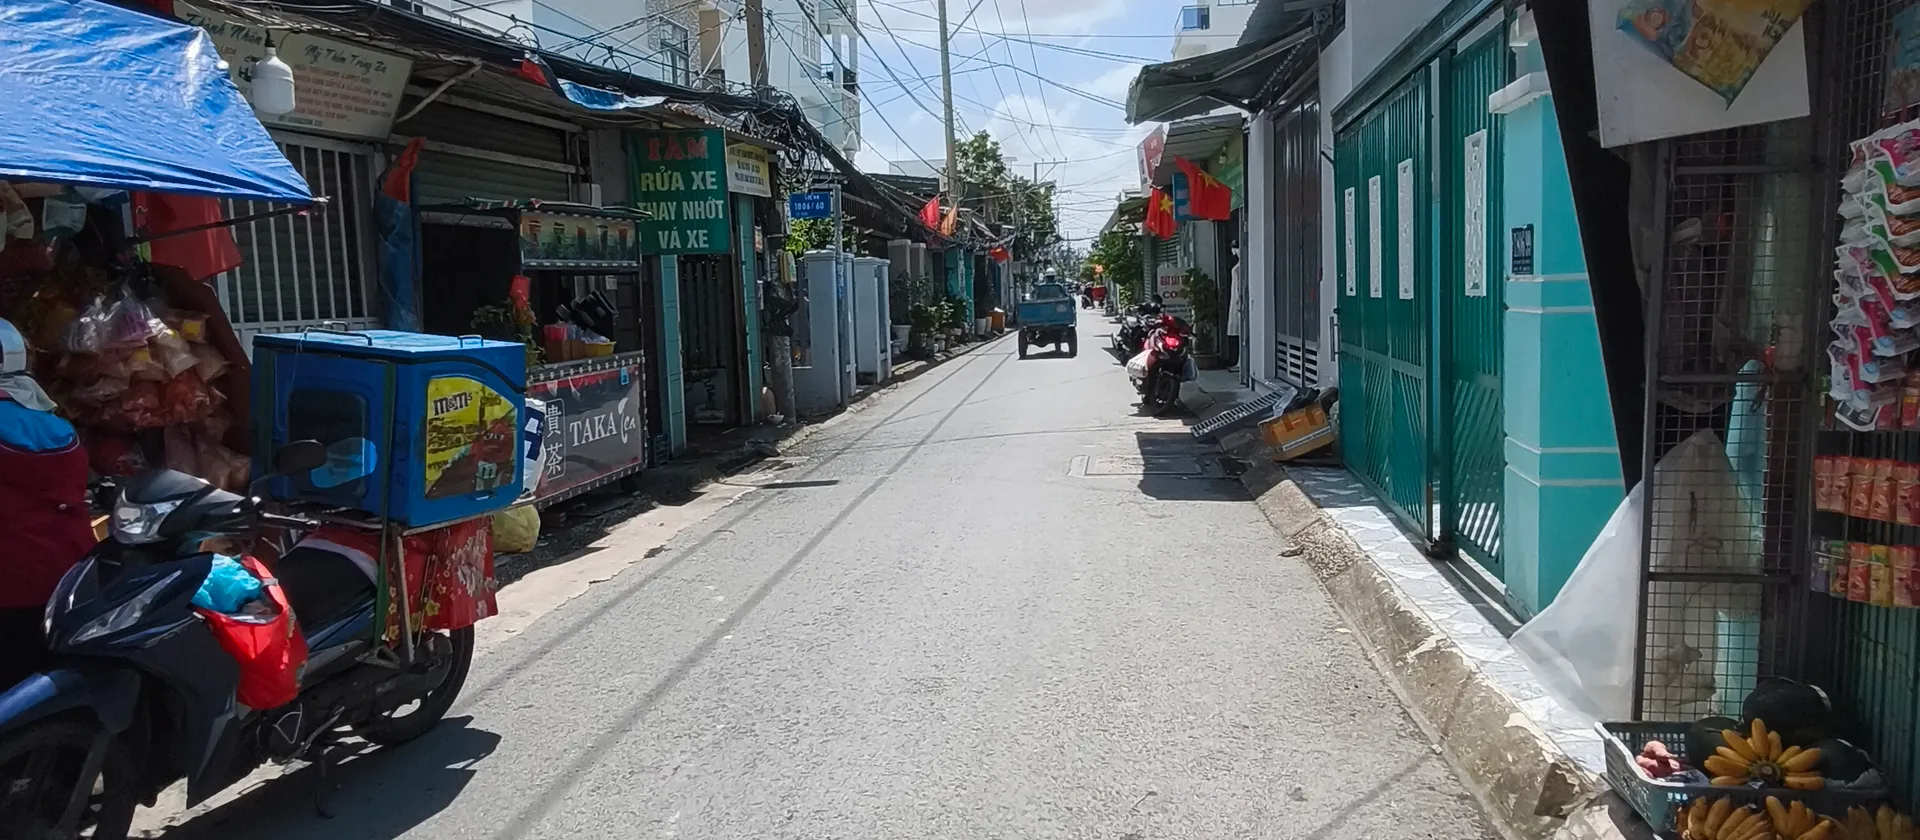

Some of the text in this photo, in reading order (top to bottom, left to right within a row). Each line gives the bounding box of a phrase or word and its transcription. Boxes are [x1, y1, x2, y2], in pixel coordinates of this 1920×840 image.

[640, 166, 685, 192] RỬA
[691, 171, 718, 190] XE
[637, 196, 724, 221] THAY NHỚT
[658, 227, 709, 249] VÁ XE
[545, 405, 563, 476] 貴茶
[569, 412, 618, 447] TAKA
